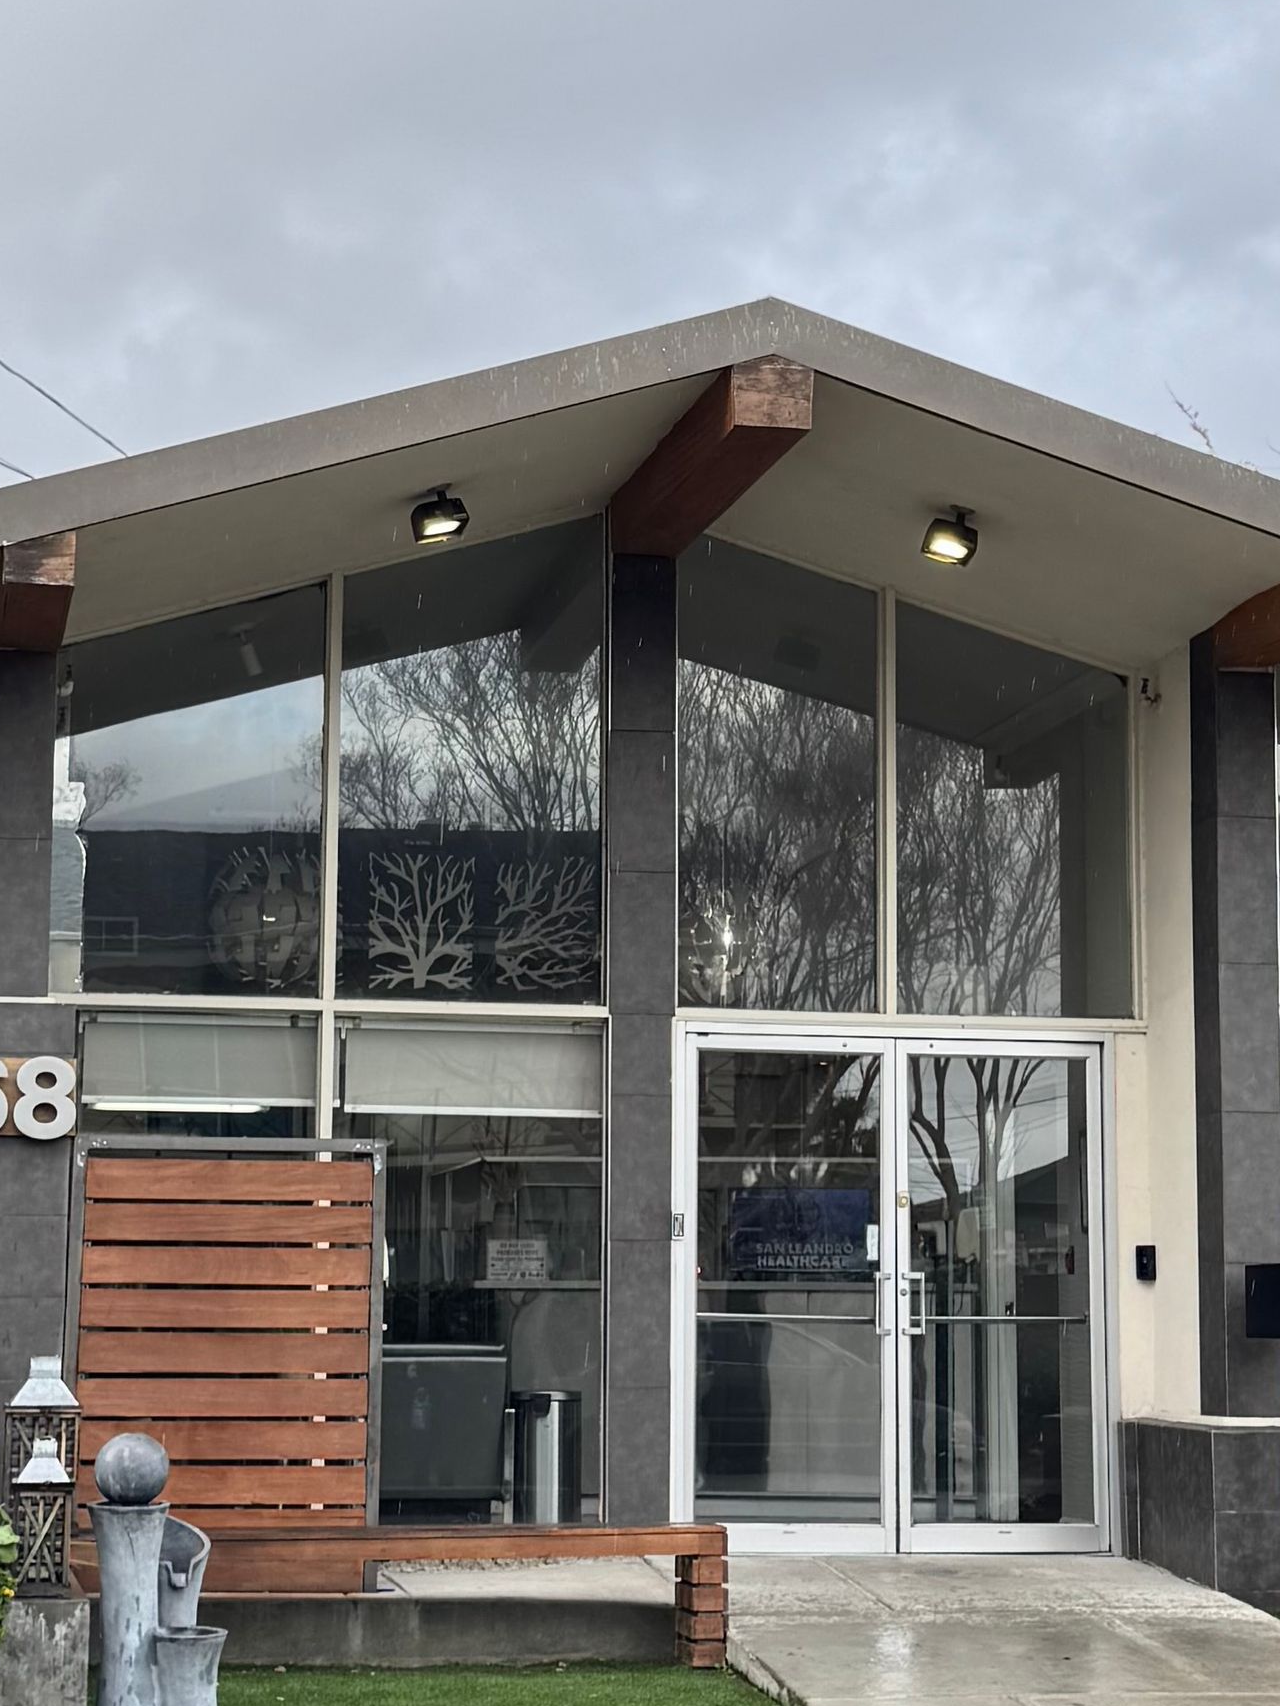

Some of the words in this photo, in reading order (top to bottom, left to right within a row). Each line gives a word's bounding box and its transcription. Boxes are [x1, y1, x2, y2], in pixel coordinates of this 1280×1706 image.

[756, 1243, 786, 1255] SAN
[789, 1242, 854, 1255] LEANDRO
[757, 1255, 849, 1268] HEALTHCARE
